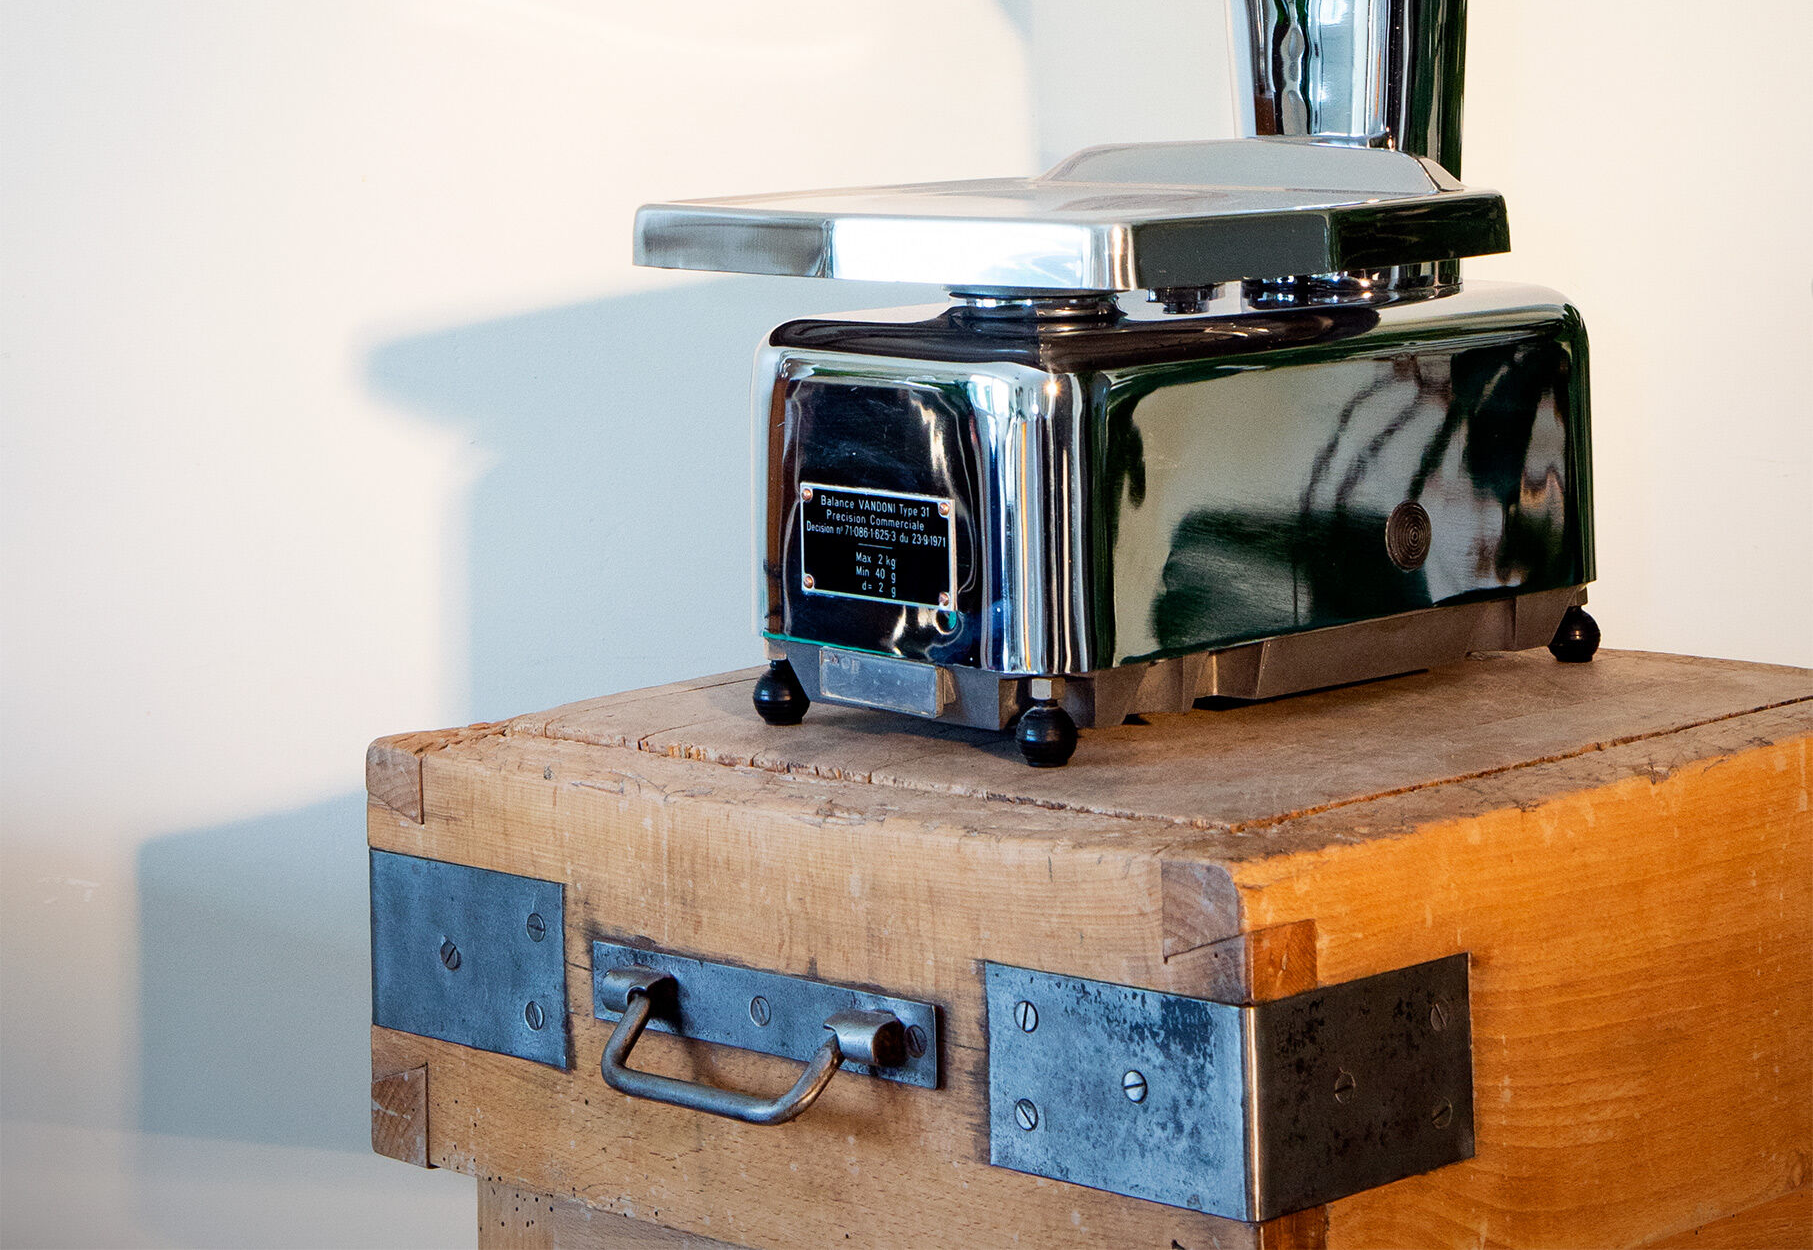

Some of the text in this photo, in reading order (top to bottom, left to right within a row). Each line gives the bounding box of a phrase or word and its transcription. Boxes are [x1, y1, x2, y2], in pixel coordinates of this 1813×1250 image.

[821, 495, 929, 517] Balance VANDONI Type 31
[827, 509, 924, 531] Precision Commerciale
[807, 521, 834, 534] Decision
[900, 533, 908, 543] du
[856, 552, 896, 569] Max 2 kg
[856, 566, 896, 583] Min 40 g
[879, 583, 883, 592] 2
[891, 587, 896, 598] g
